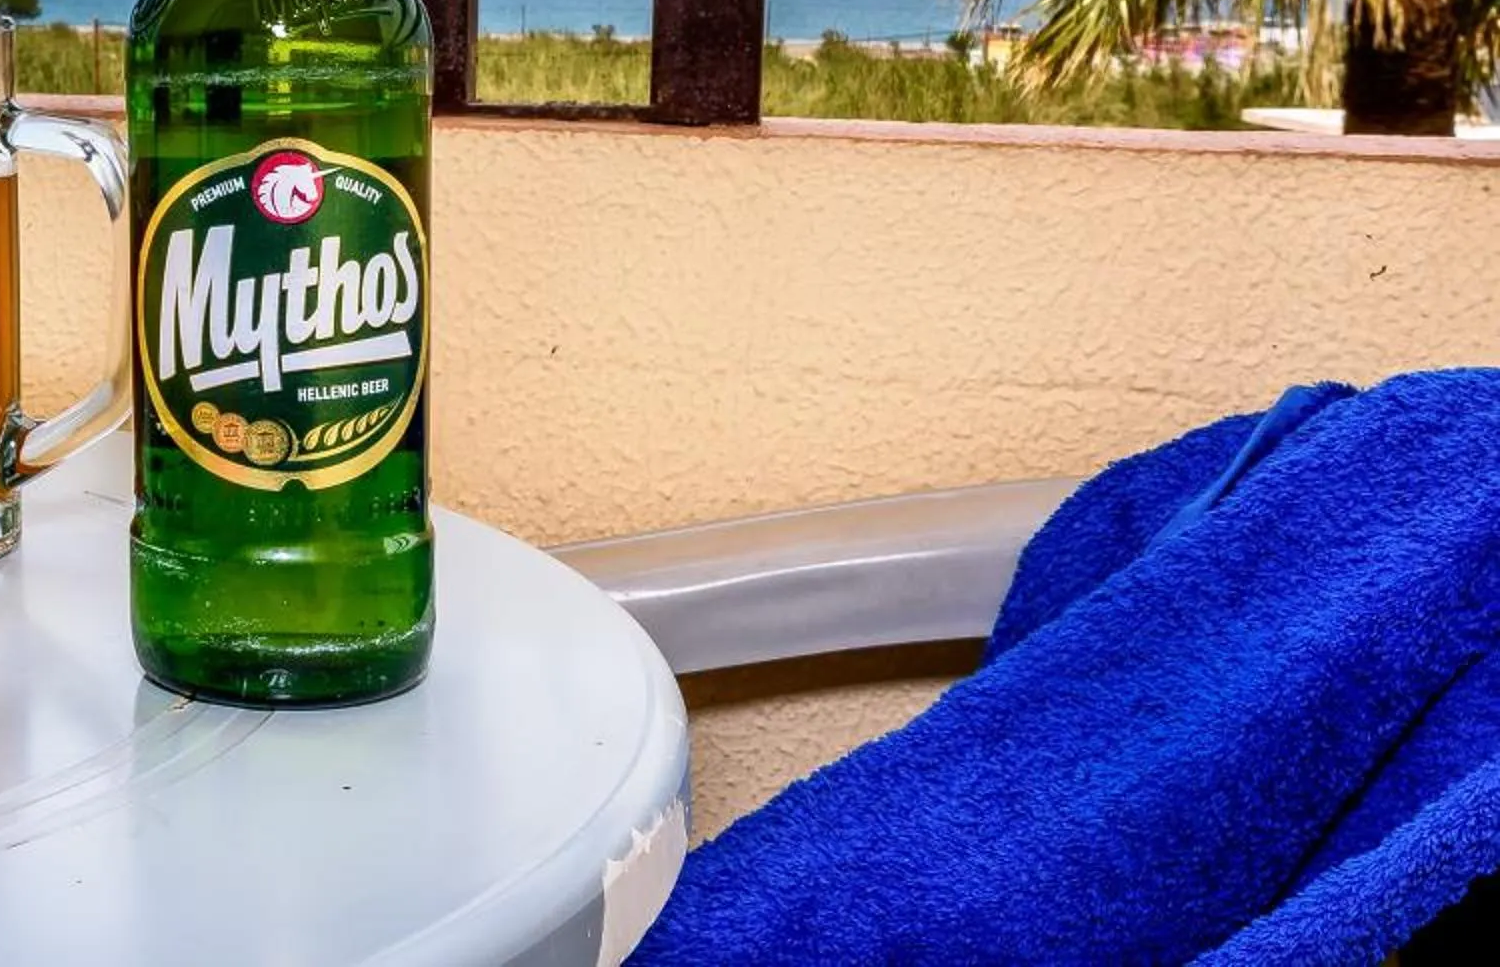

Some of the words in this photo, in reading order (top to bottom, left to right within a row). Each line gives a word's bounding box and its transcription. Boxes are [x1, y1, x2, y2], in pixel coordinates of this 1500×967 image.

[190, 176, 246, 211] PREMIUM
[334, 175, 383, 204] QUALITY
[159, 224, 419, 393] Mythos
[297, 383, 359, 403] HELLENIC
[361, 378, 390, 397] BEER
